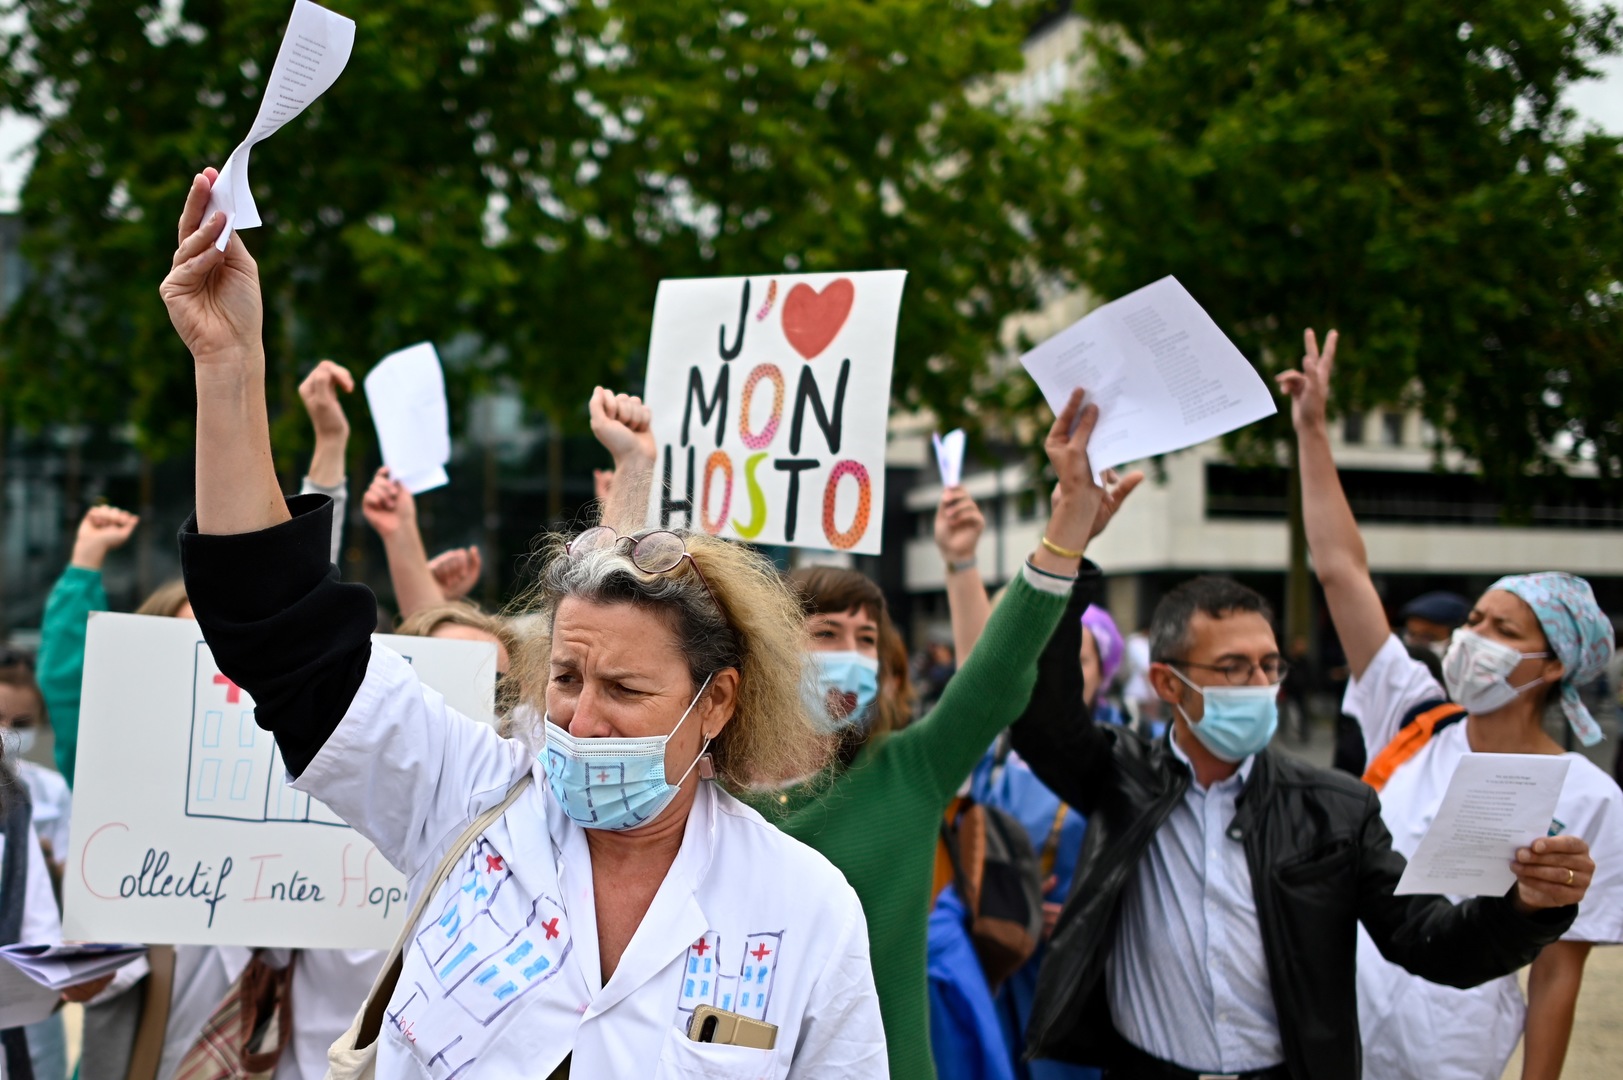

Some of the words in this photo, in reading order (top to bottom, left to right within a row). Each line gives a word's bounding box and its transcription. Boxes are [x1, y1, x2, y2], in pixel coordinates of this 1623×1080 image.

[680, 358, 851, 456] MON
[660, 443, 872, 550] HOSTO
[81, 822, 233, 929] Collectif
